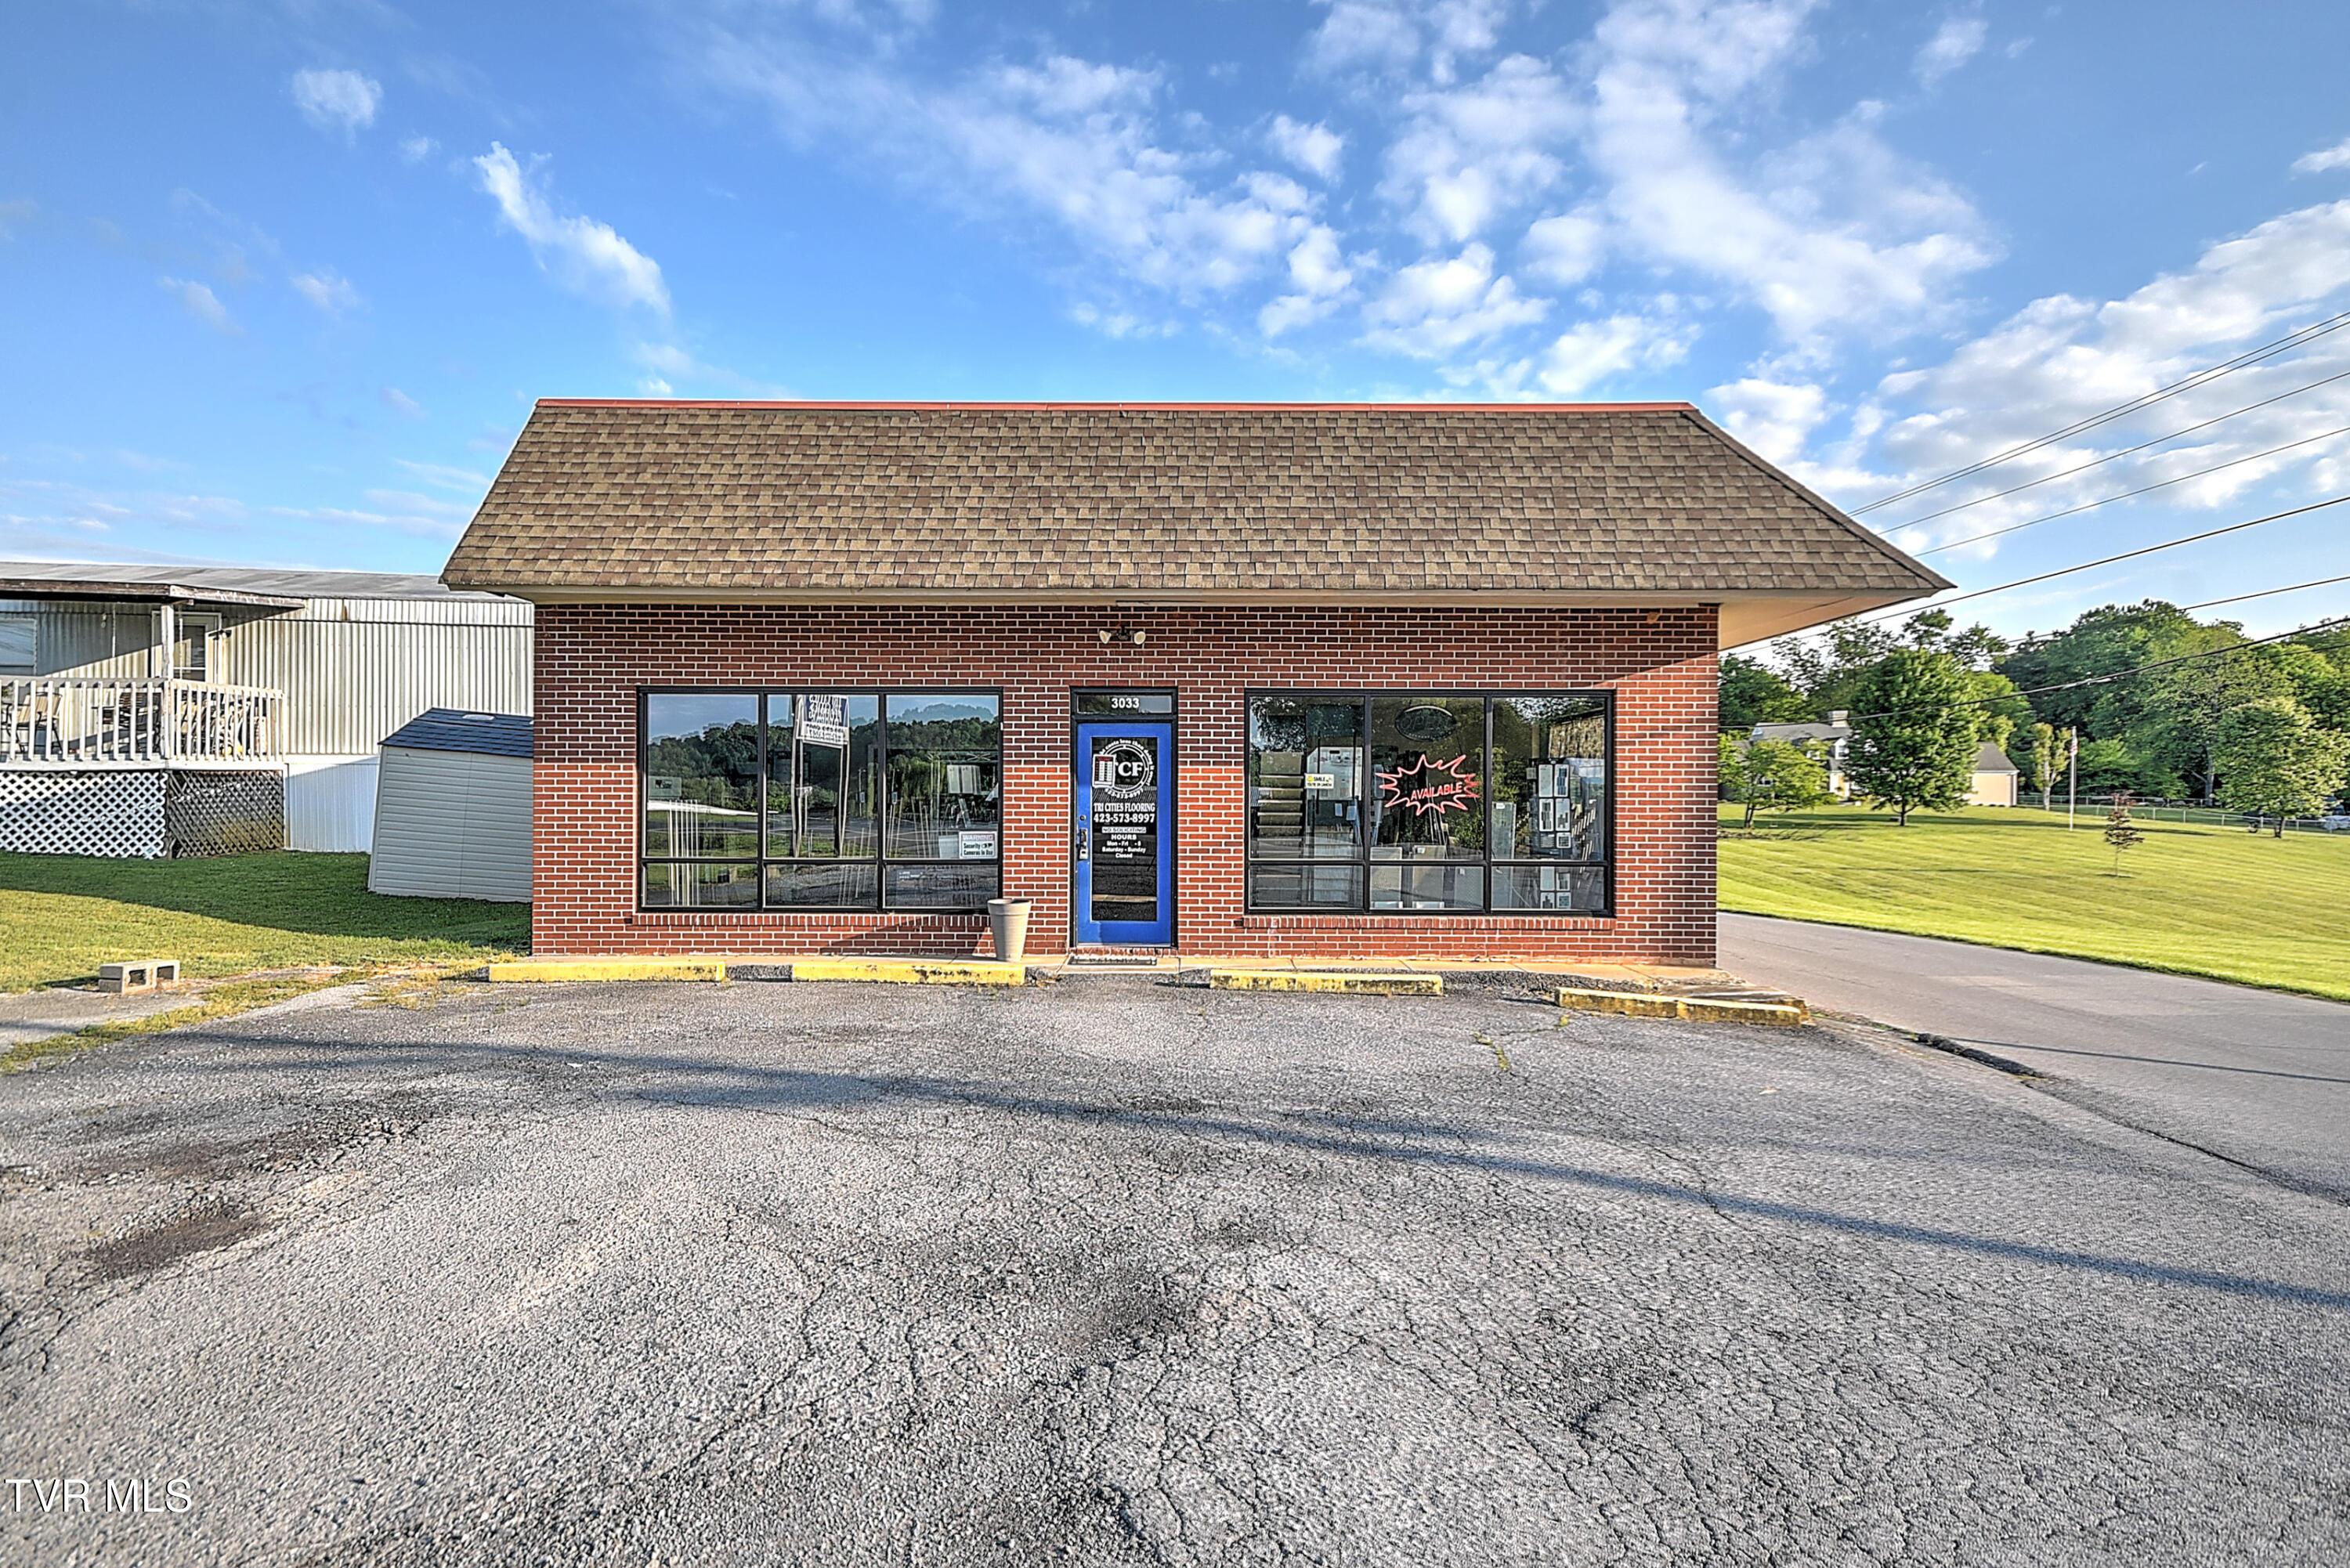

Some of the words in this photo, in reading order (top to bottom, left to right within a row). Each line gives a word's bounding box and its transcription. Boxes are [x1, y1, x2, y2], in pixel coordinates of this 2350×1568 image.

[1111, 697, 1140, 709] 3033
[1115, 761, 1144, 777] CF
[1411, 782, 1463, 800] AVAILABLE
[1093, 803, 1104, 812] TRI
[1104, 803, 1124, 812] CITIES
[1124, 803, 1155, 812] FLOORING
[1094, 813, 1155, 823] 423-573-8997
